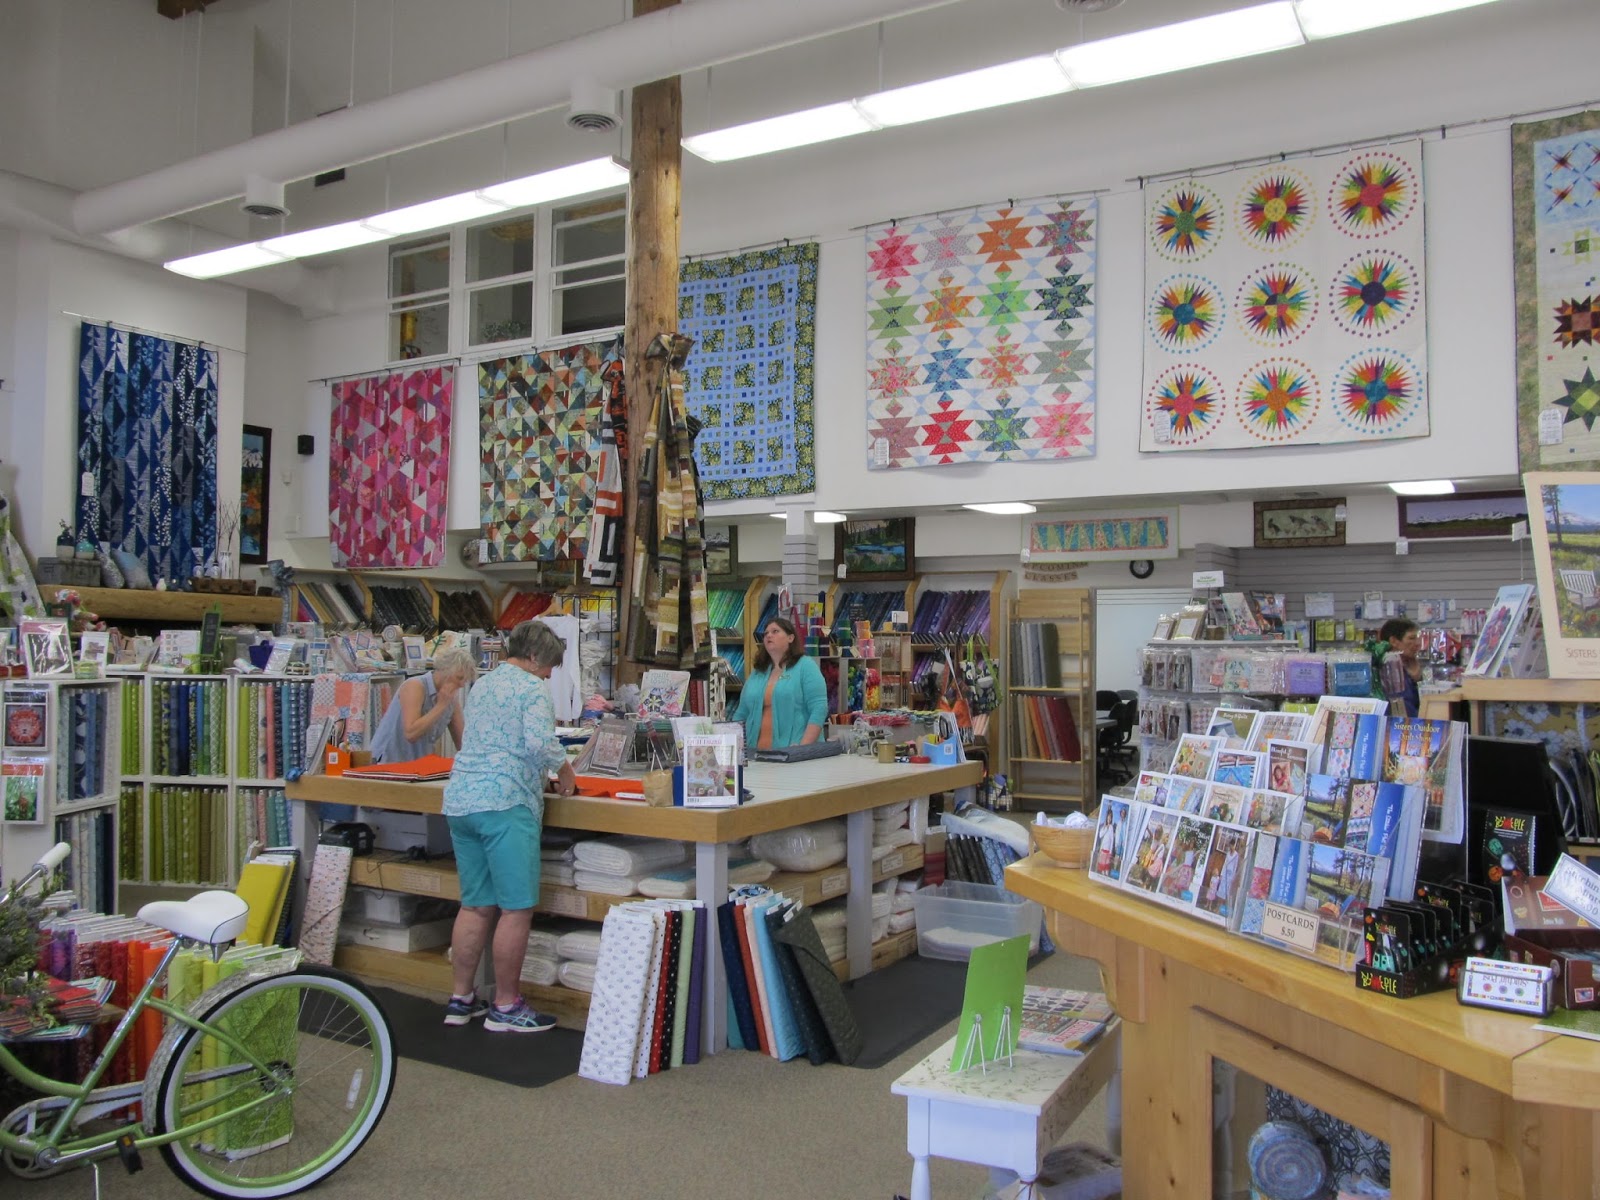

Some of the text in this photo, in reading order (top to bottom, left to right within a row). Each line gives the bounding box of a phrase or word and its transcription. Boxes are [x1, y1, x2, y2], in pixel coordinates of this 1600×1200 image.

[1566, 648, 1597, 658] SISTERS
[1393, 722, 1440, 733] Sisters Outdoor
[1266, 908, 1315, 931] POSTCARDS
[1281, 926, 1295, 938] $.50
